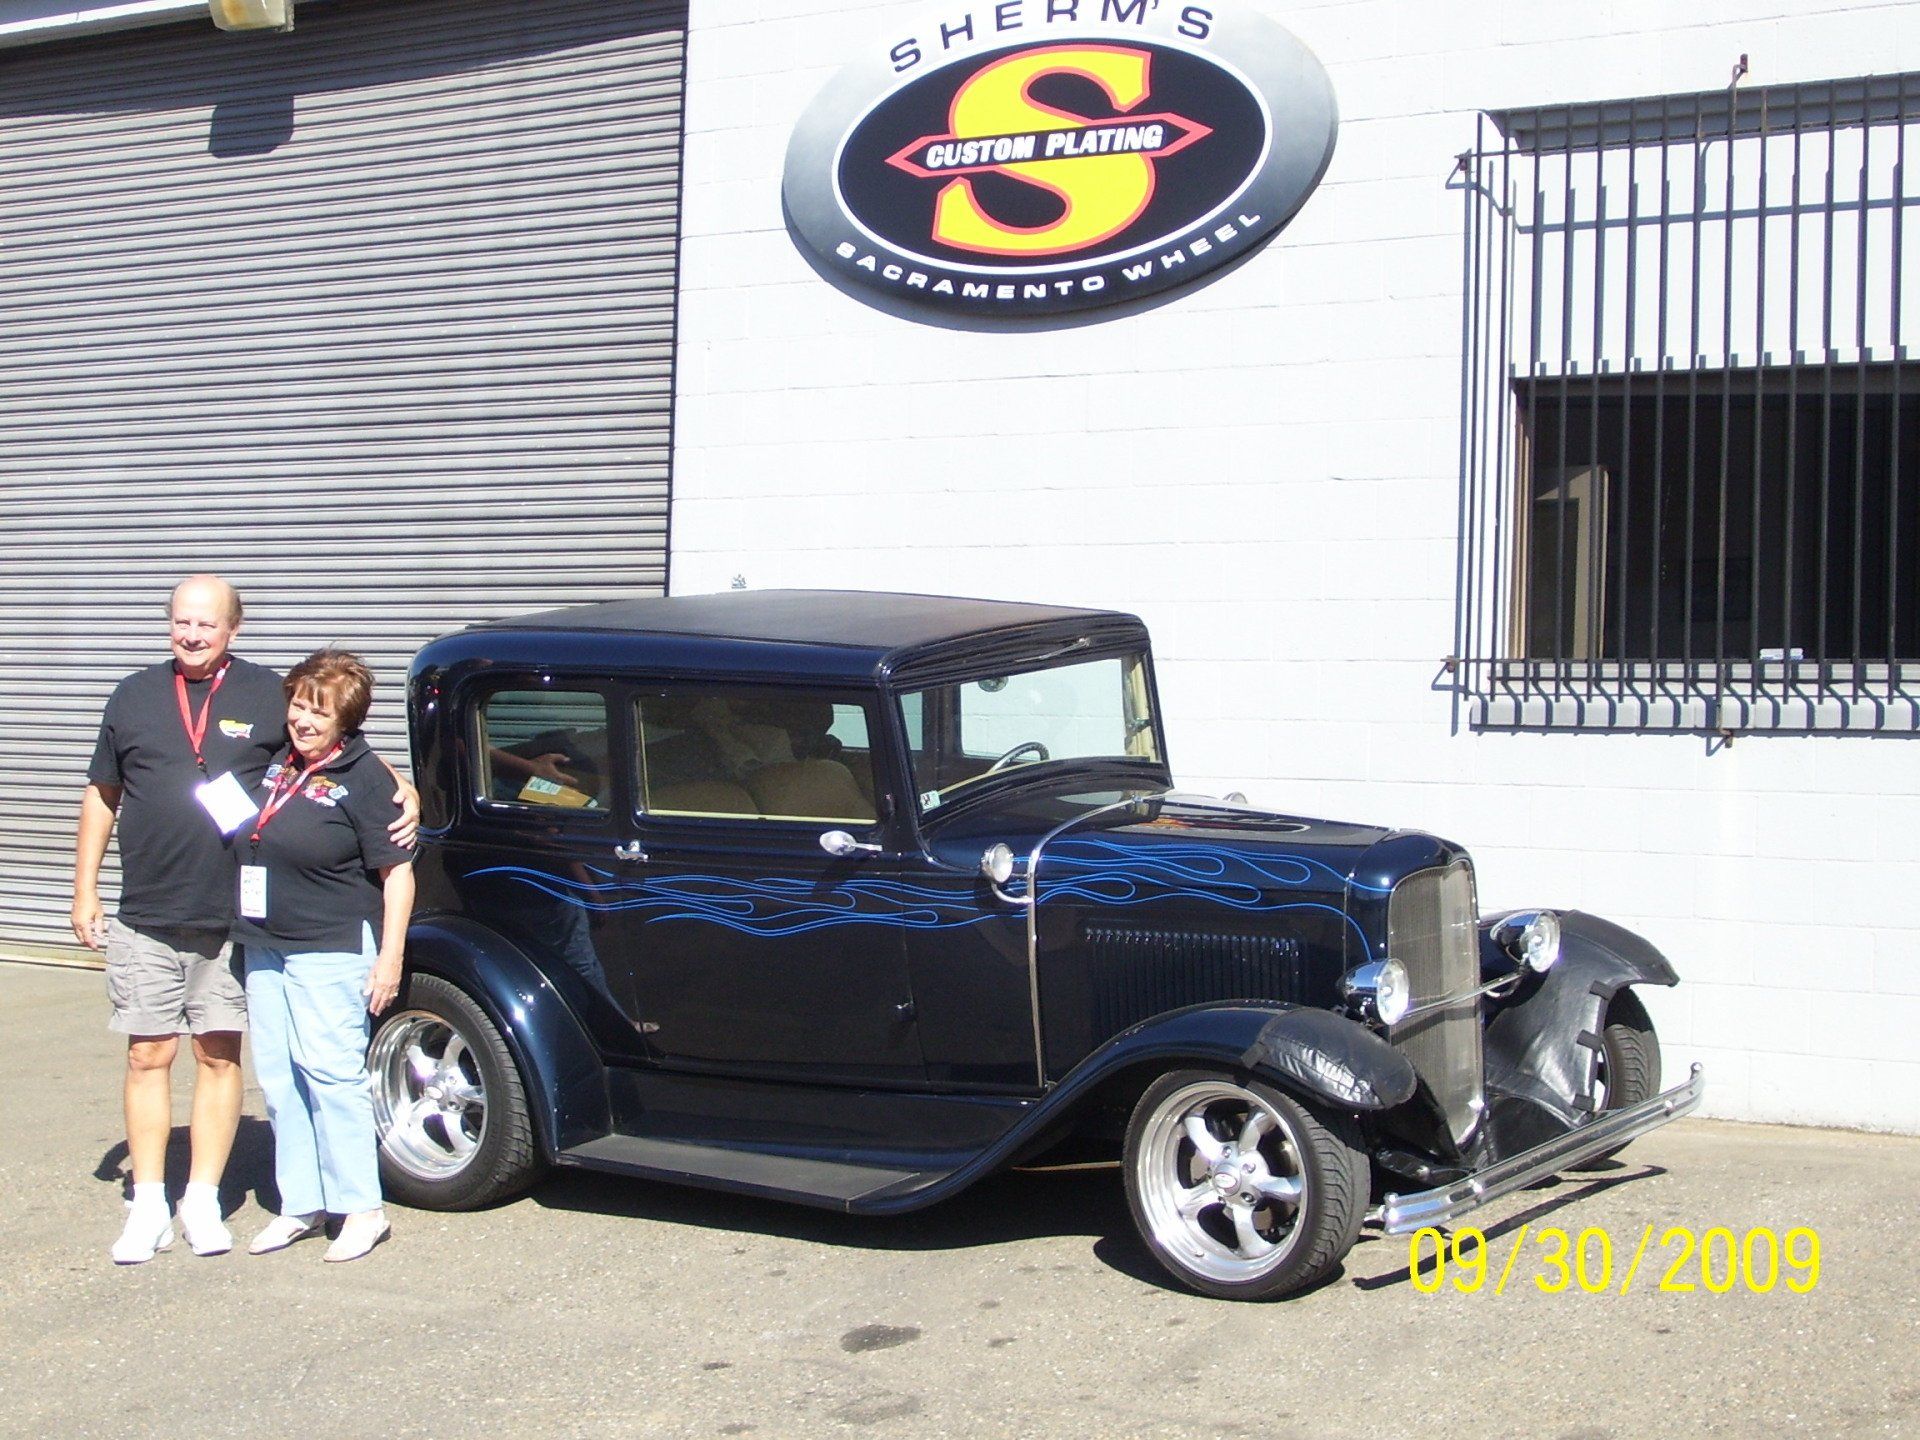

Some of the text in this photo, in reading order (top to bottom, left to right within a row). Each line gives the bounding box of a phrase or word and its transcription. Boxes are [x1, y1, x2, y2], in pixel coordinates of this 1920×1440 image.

[889, 0, 1214, 73] SHERM'S
[926, 125, 1164, 168] CUSTOM PLATING
[836, 212, 1261, 300] SACRAMENTO WHEEL
